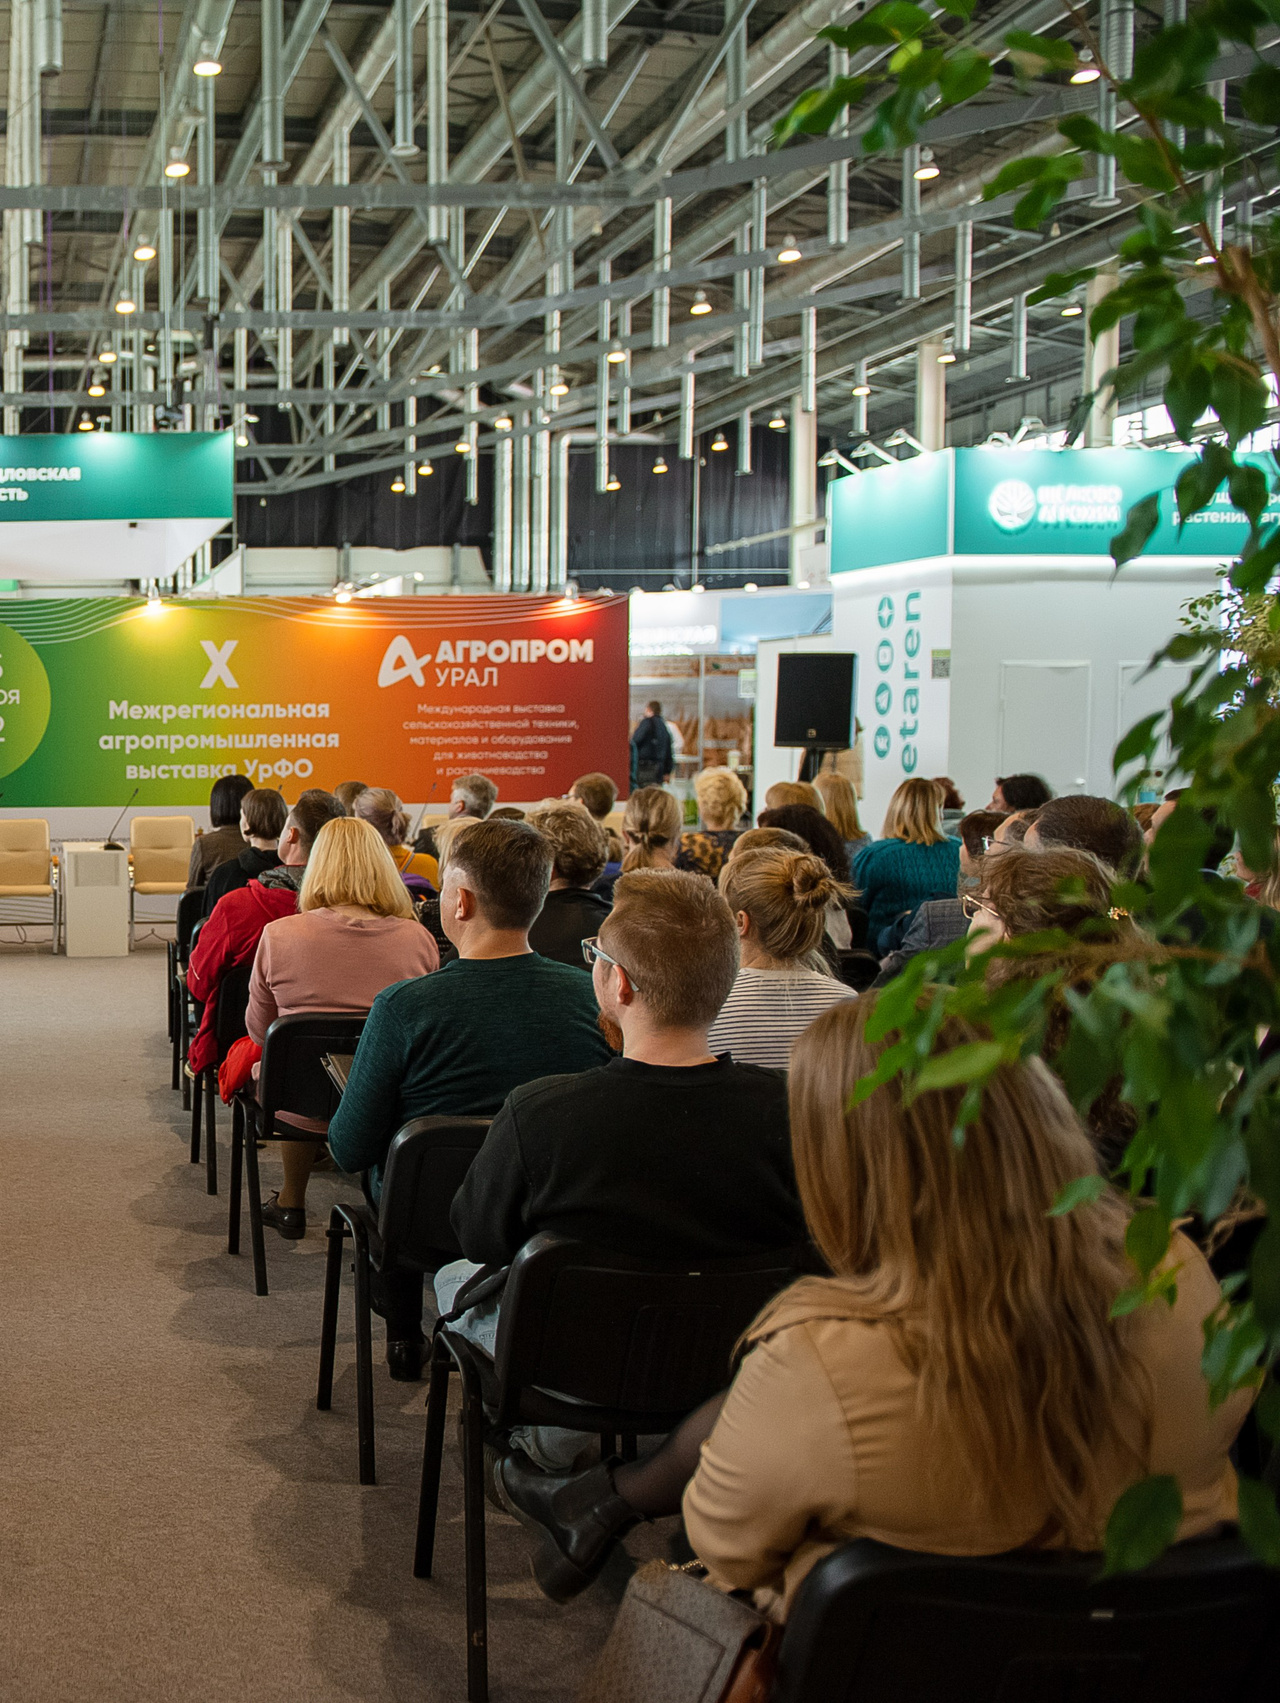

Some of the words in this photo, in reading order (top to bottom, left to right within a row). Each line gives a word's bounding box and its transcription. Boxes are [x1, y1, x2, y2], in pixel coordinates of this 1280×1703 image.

[1172, 511, 1252, 527] растени
[435, 638, 594, 664] АГРОПРОМ
[435, 666, 498, 688] УРАЛ
[900, 591, 921, 775] etaren
[108, 699, 330, 724] Межрегиональная
[417, 704, 511, 716] Международная
[513, 704, 565, 714] выставка
[402, 718, 530, 730] сельскохозяйственной
[98, 733, 340, 754] агропромышленная
[409, 735, 480, 746] материалов
[481, 736, 489, 745] и
[490, 734, 573, 746] оборудования
[433, 751, 454, 762] для
[125, 763, 237, 780] выставка
[243, 757, 314, 783] УрФО
[436, 767, 444, 776] и
